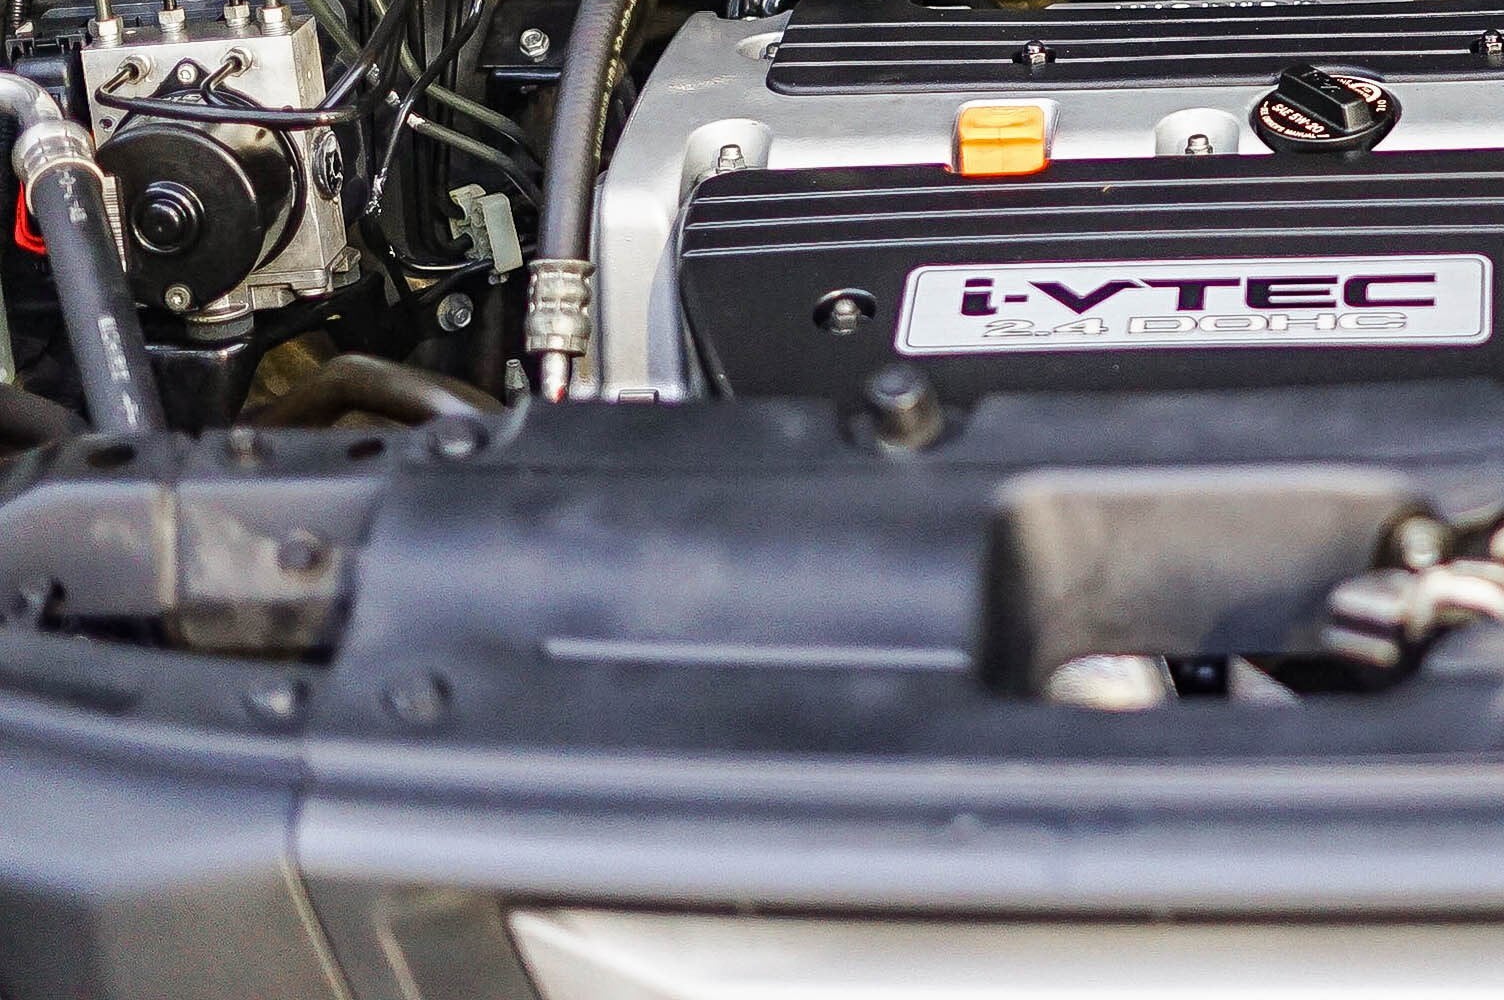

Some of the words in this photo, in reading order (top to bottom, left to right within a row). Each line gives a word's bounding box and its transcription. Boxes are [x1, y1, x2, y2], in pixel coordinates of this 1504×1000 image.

[1271, 103, 1293, 118] SAE
[961, 274, 1436, 316] i-VTEC
[981, 317, 1110, 338] 2.4
[1128, 311, 1408, 335] DOHC
